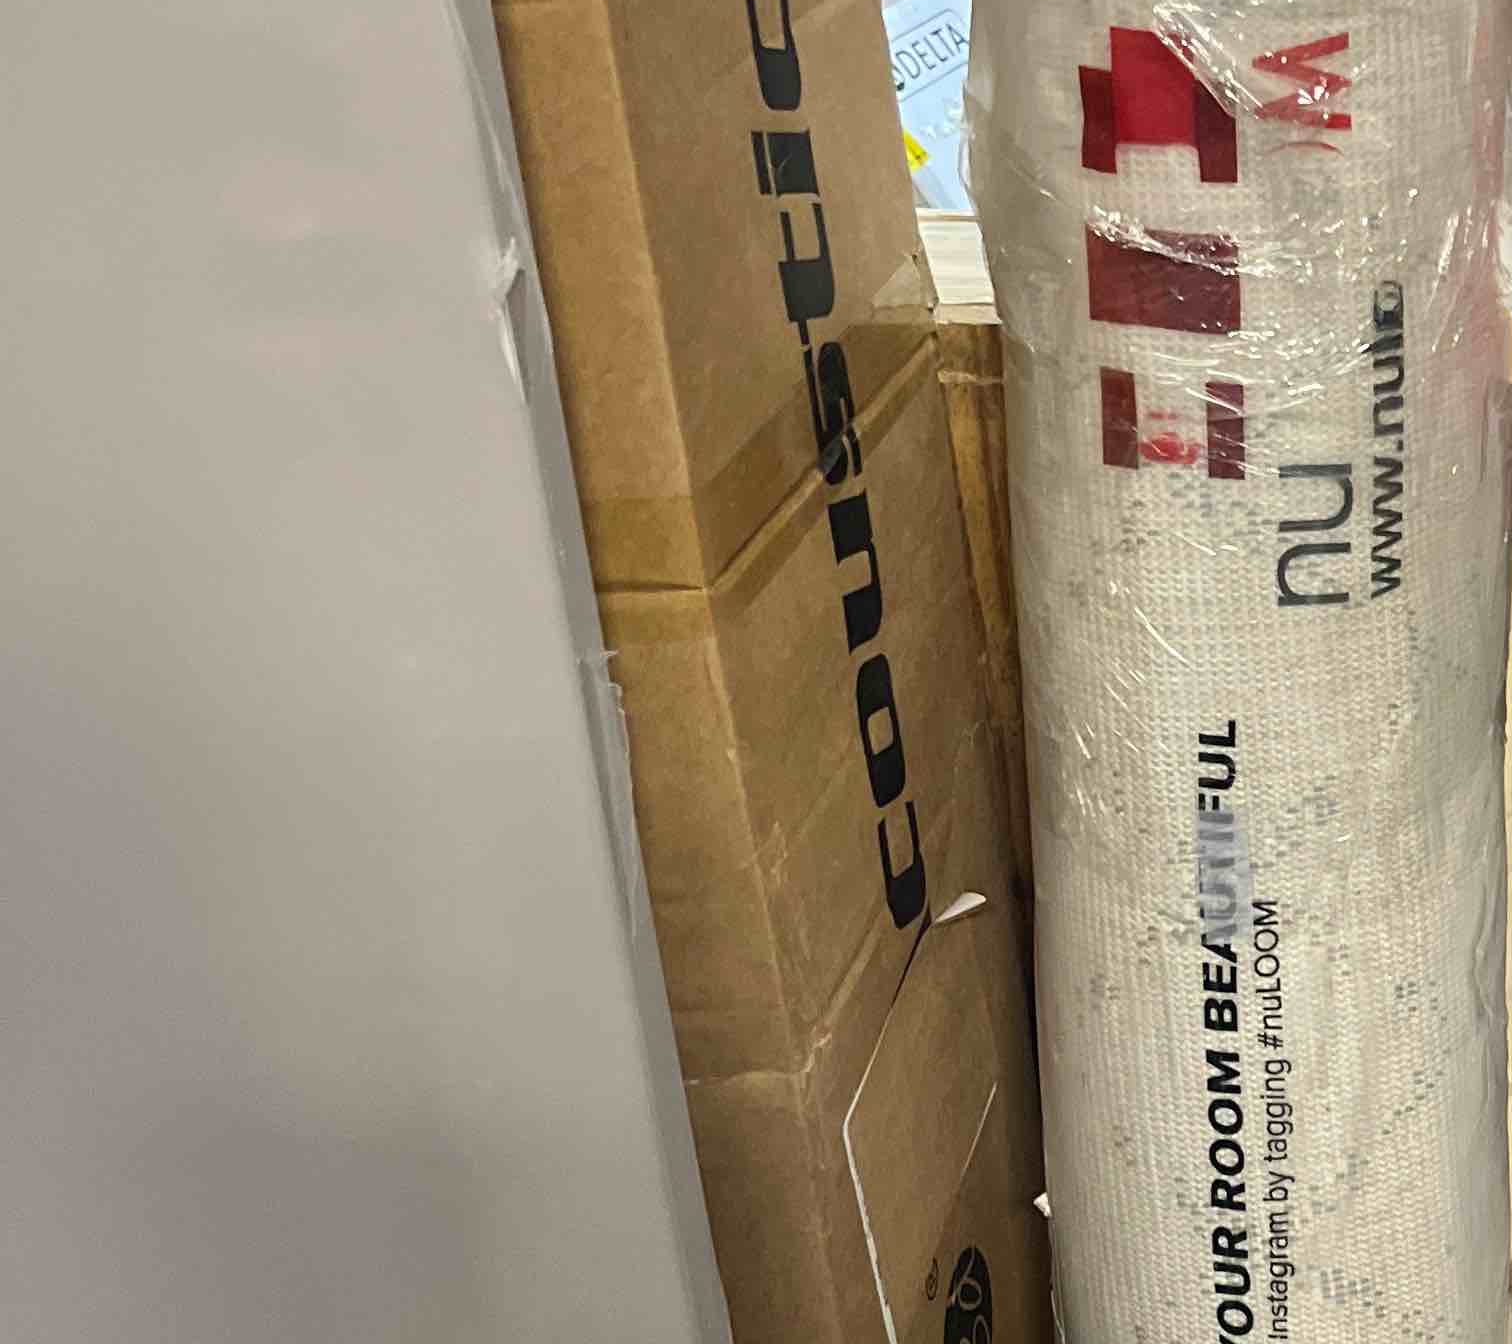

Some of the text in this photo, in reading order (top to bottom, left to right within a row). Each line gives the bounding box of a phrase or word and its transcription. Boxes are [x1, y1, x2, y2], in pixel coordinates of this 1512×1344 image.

[1274, 462, 1354, 607] nu
[1197, 719, 1243, 1033] BEAUTIFUL
[1252, 900, 1287, 1050] #nuLOOM
[1205, 1050, 1247, 1212] ROOM
[1258, 1059, 1293, 1163] tagging
[1262, 1171, 1294, 1202] by
[1260, 1211, 1295, 1341] Instagram
